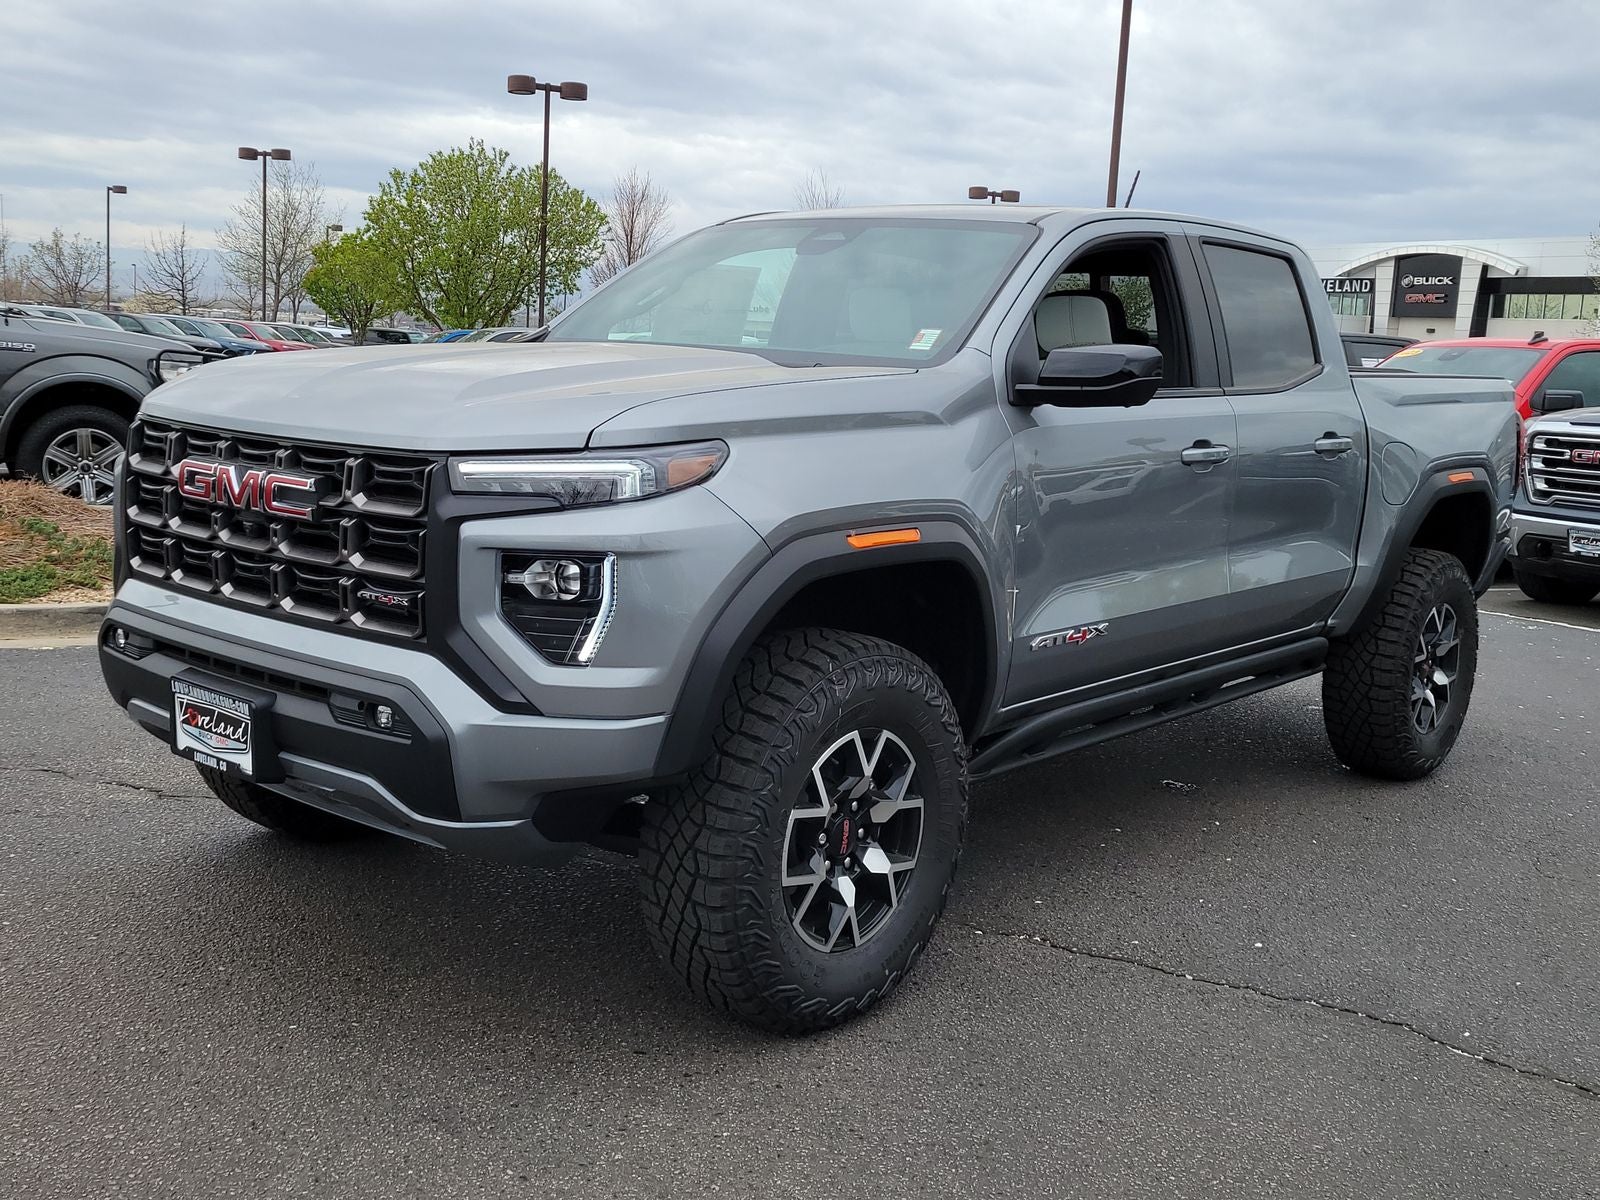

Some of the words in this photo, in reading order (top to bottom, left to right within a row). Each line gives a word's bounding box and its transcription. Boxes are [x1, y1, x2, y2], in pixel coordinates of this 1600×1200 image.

[1413, 276, 1454, 286] BUICK
[1405, 293, 1445, 304] GMC
[178, 459, 316, 521] GMC
[1029, 622, 1109, 651] AT4X
[215, 736, 229, 747] GMC
[840, 818, 850, 855] GMC
